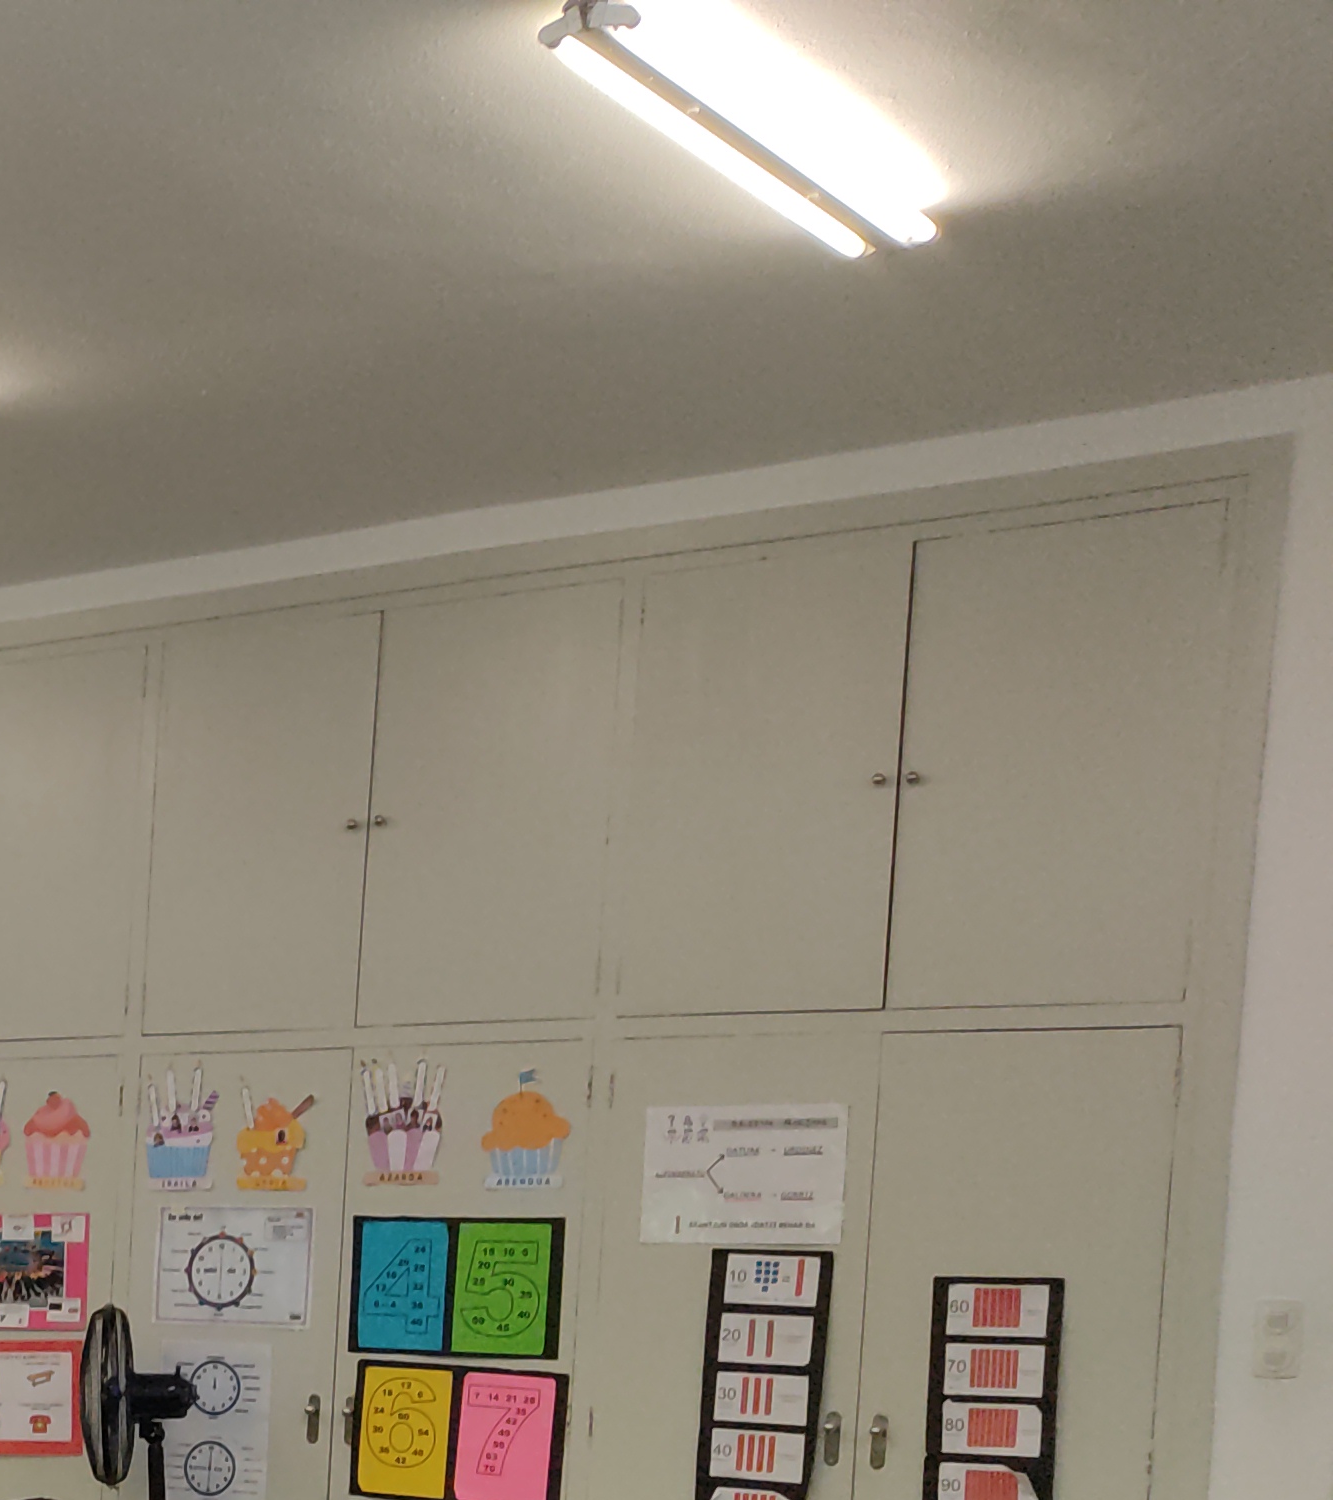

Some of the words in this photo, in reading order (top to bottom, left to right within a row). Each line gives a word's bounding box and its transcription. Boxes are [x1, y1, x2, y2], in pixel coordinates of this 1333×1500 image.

[379, 1173, 423, 1182] AZAROA
[496, 1177, 551, 1186] ABENDUA
[503, 1247, 515, 1257] 10
[477, 1260, 491, 1270] 20
[730, 1270, 747, 1284] 10
[949, 1300, 970, 1314] 60
[517, 1310, 531, 1319] 40
[496, 1323, 510, 1332] 45
[721, 1328, 742, 1342] 20
[947, 1360, 967, 1373] 70
[489, 1392, 500, 1402] 14
[505, 1393, 517, 1404] 21
[717, 1387, 737, 1401] 30
[945, 1418, 965, 1432] 80
[712, 1443, 732, 1457] 40
[941, 1478, 961, 1492] 90
